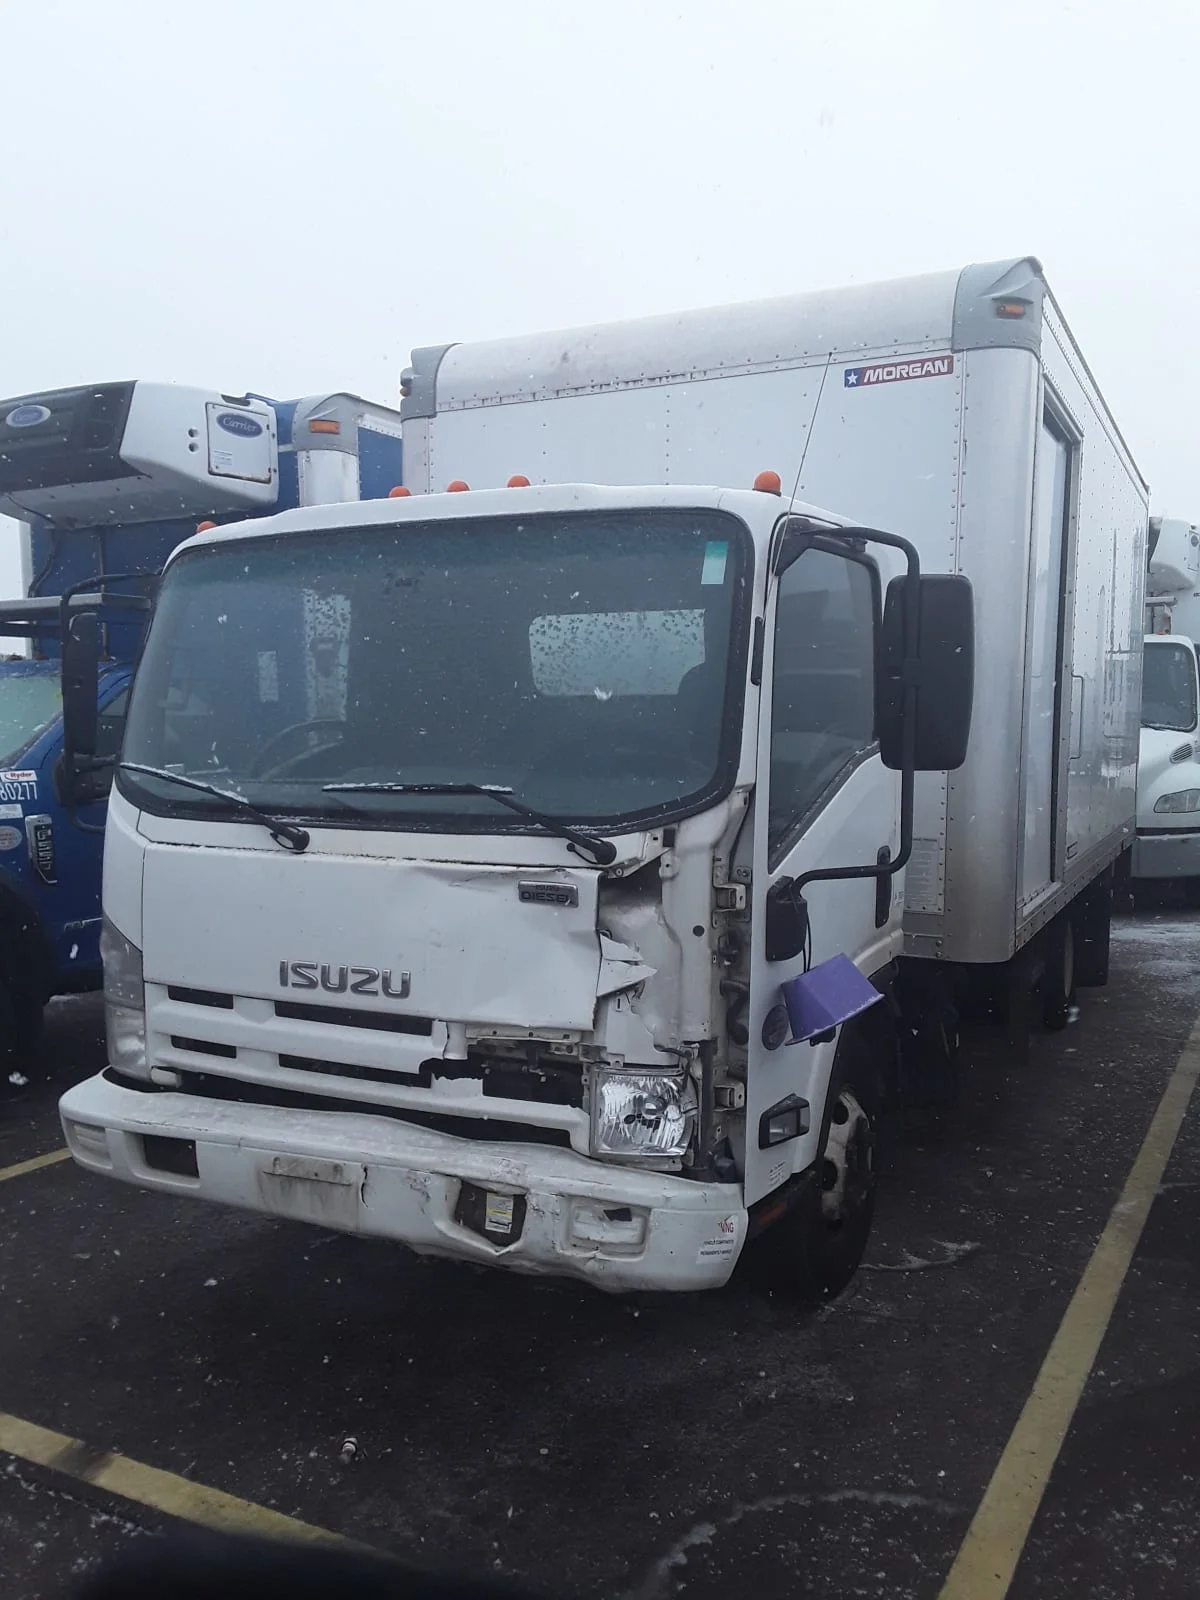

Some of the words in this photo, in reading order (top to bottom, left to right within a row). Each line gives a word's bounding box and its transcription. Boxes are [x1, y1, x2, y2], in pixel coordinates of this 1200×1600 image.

[863, 359, 949, 383] MORGAN
[223, 417, 258, 432] Carrier
[279, 959, 412, 999] ISUZU
